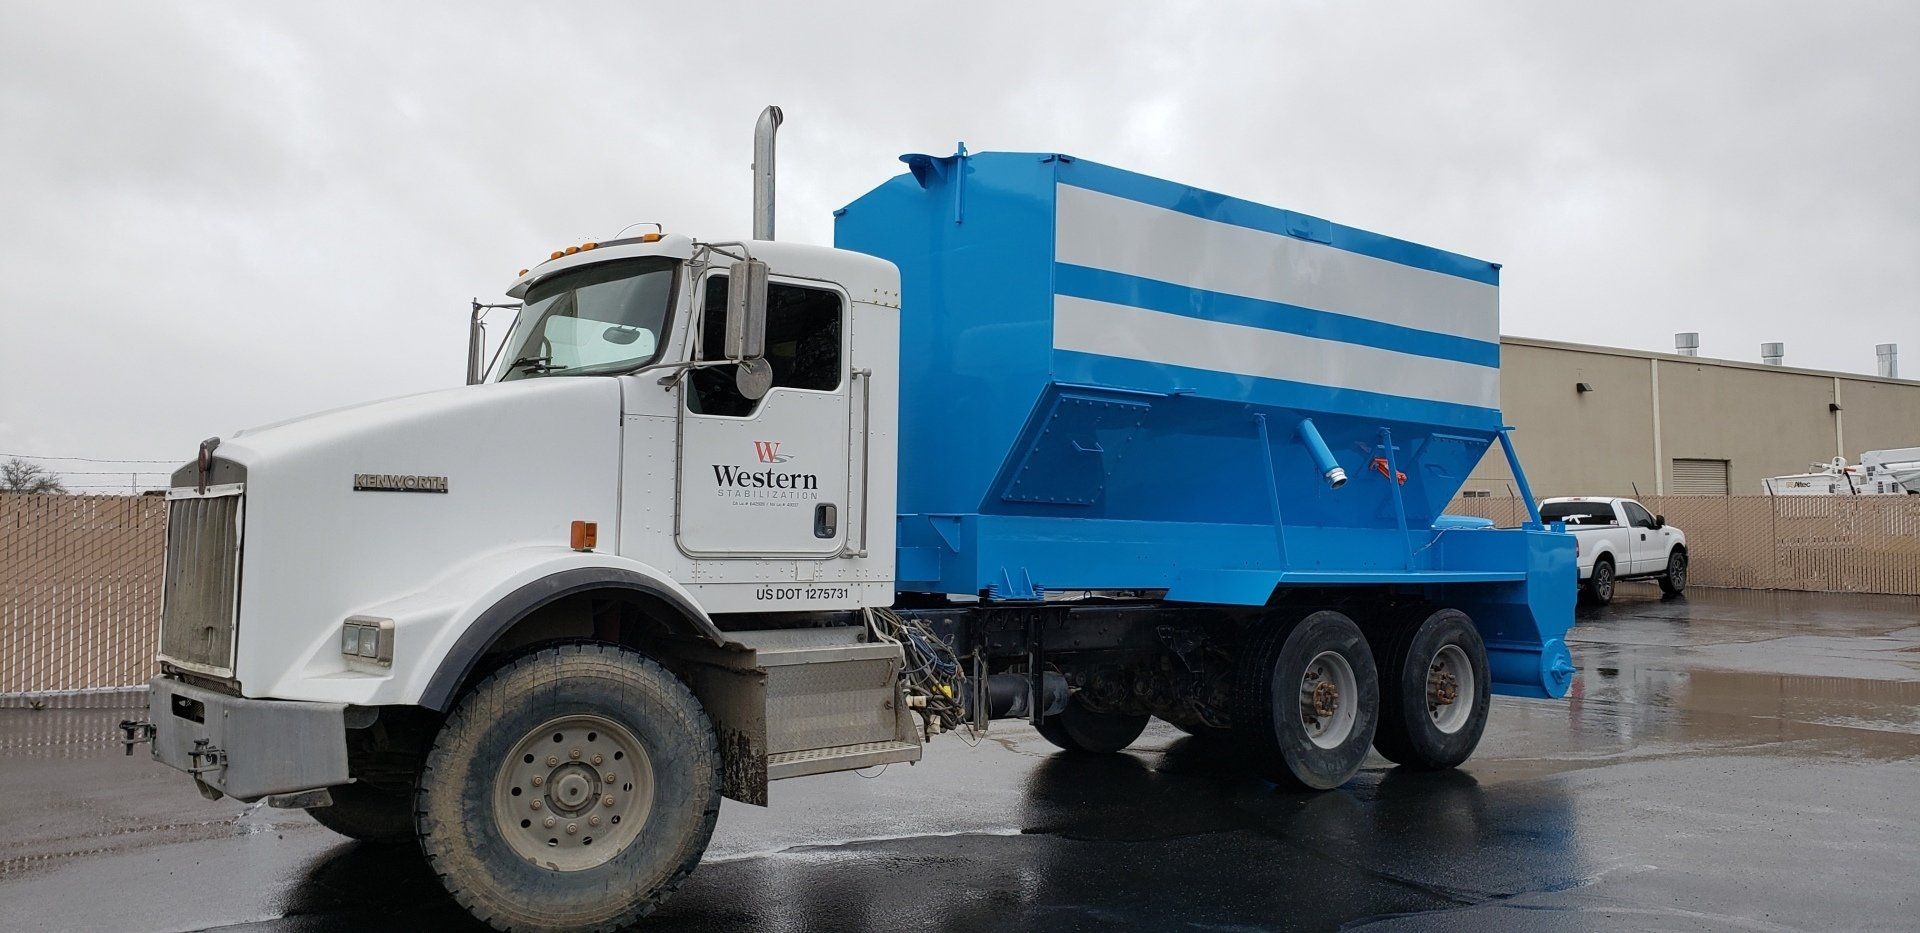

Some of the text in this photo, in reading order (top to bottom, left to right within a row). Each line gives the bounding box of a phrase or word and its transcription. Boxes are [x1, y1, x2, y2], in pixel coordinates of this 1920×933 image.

[354, 474, 448, 490] KENWORTH
[711, 464, 818, 490] Western
[717, 489, 818, 500] STABILIZATION
[756, 588, 848, 600] US DOT 1275731
